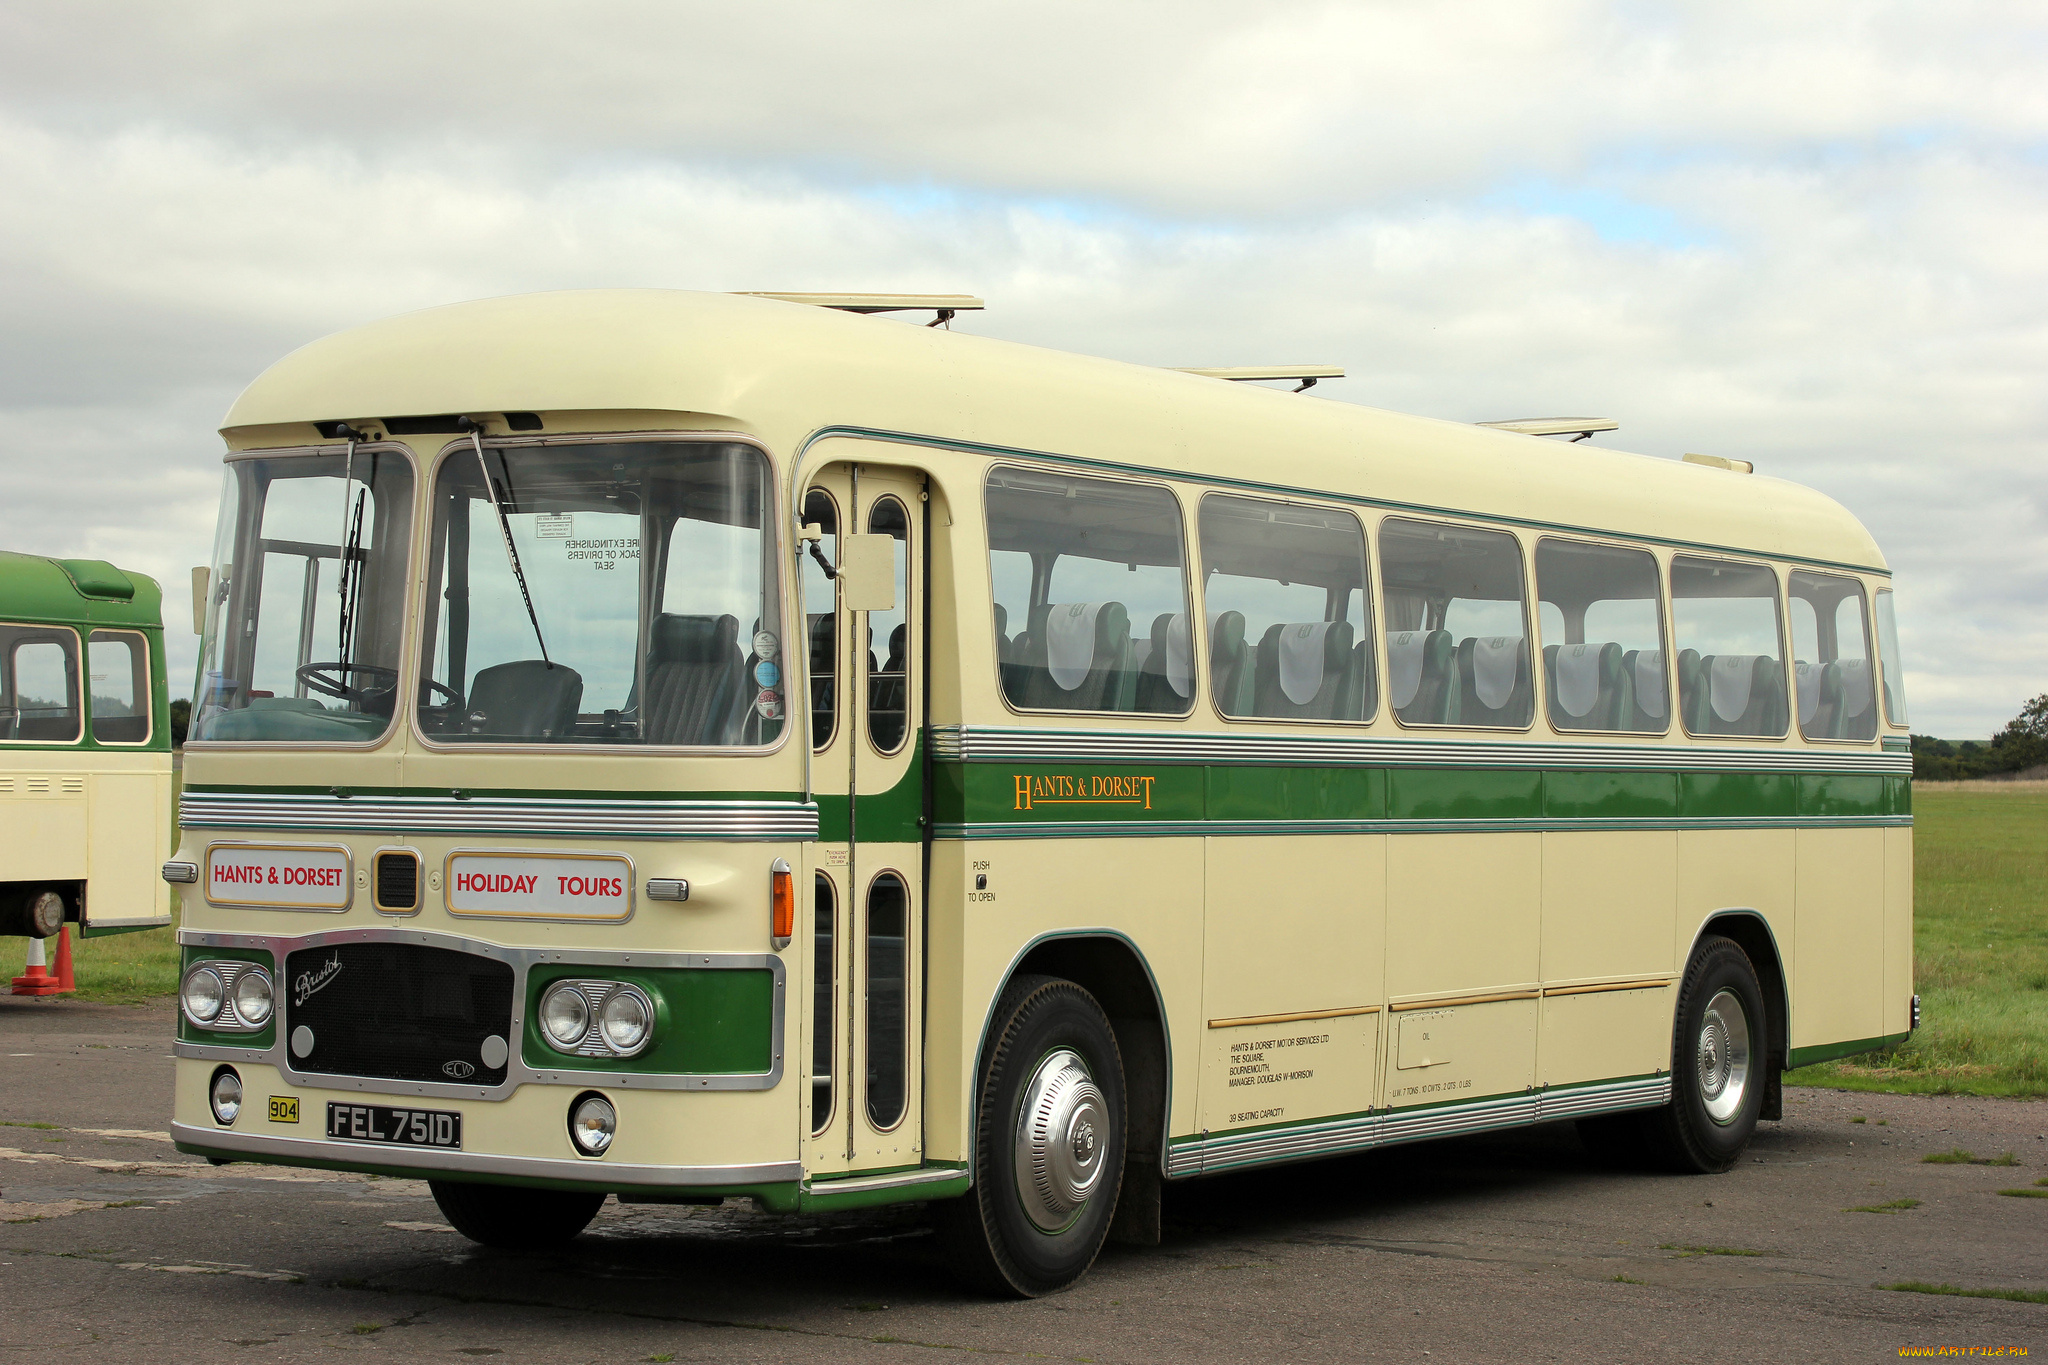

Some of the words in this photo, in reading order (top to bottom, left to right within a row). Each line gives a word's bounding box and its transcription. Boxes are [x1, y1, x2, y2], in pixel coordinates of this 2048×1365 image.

[1013, 775, 1074, 810] HANTS
[1077, 777, 1087, 797] &
[1091, 776, 1155, 810] DORSET
[973, 861, 990, 870] PUSH
[214, 865, 263, 884] HANTS
[267, 866, 279, 885] &
[284, 867, 343, 886] DORSET
[457, 873, 538, 894] HOLIDAY
[557, 876, 622, 897] TOURS
[968, 893, 976, 902] TO
[978, 893, 996, 902] OPEN
[295, 949, 343, 1007] Bristol
[1230, 1042, 1249, 1053] HANTS
[1249, 1042, 1254, 1051] &
[1255, 1039, 1276, 1050] DORSET
[1276, 1038, 1295, 1049] MOTOR
[1295, 1035, 1320, 1046] SERVICES
[1320, 1034, 1330, 1043] LTD
[1422, 1032, 1430, 1041] OIL
[1230, 1054, 1241, 1064] THE
[446, 1062, 471, 1077] ECW
[1257, 1072, 1283, 1085] DOUGLAS
[1443, 1082, 1447, 1091] 2
[1463, 1079, 1472, 1088] LBS
[270, 1101, 297, 1118] 904
[1229, 1113, 1237, 1123] 39
[1237, 1110, 1259, 1122] SEATING
[1259, 1107, 1285, 1119] CAPACITY
[334, 1106, 385, 1139] FEL
[392, 1110, 453, 1145] 751D
